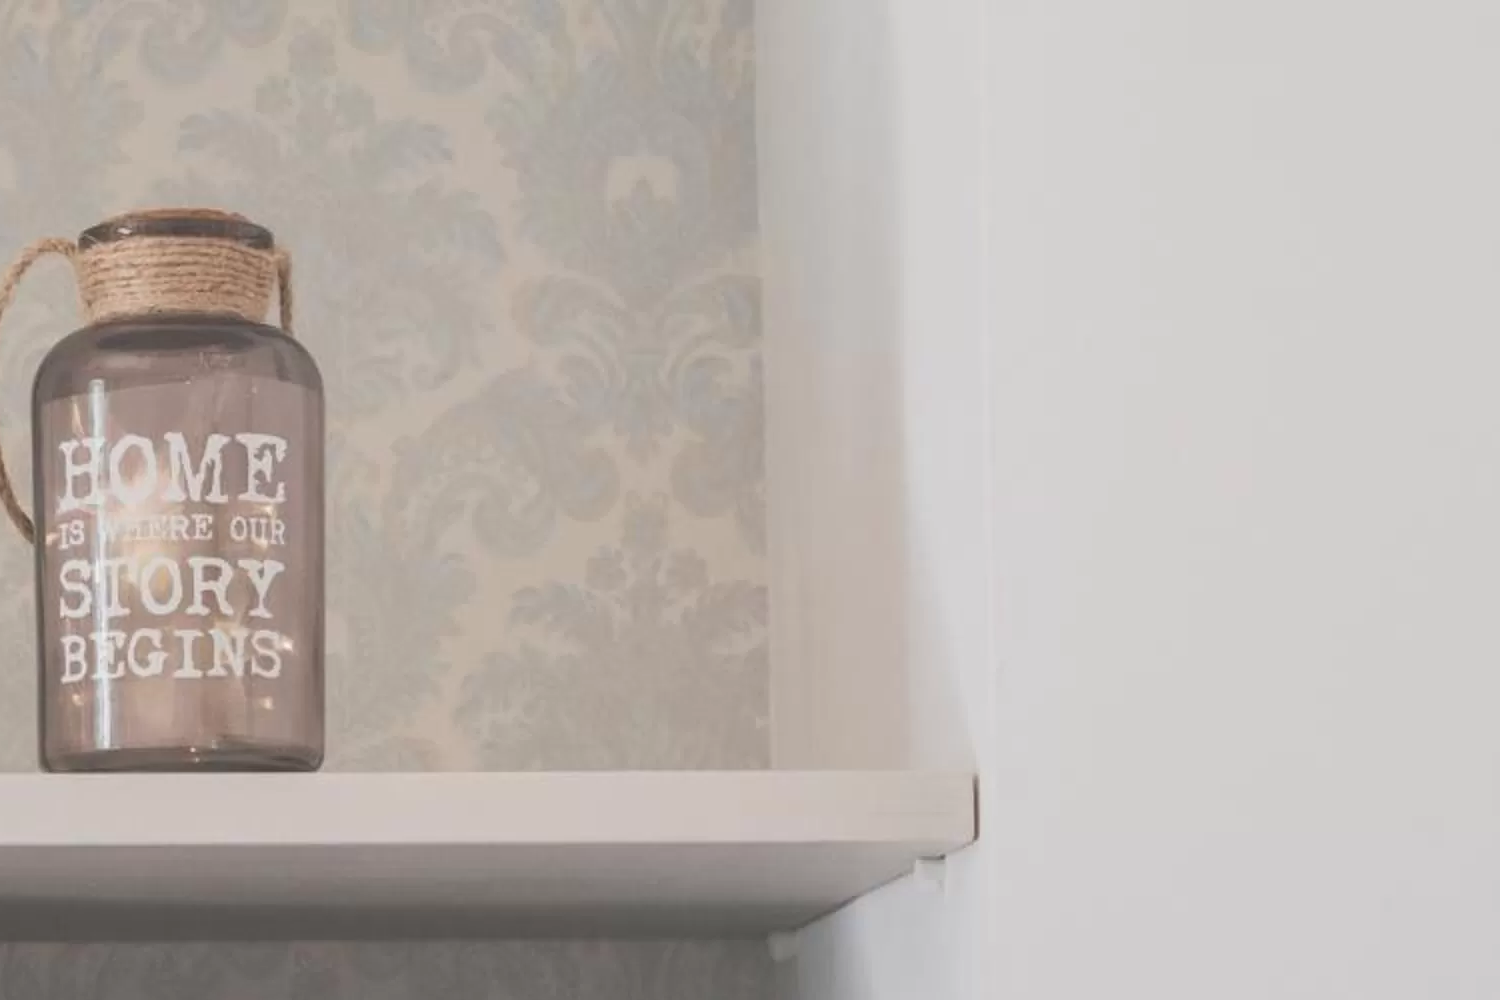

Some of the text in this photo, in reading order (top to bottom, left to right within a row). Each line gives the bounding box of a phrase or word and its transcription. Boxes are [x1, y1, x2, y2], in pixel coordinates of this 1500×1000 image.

[58, 432, 288, 513] HOME
[58, 513, 286, 549] IS WHERE OUR
[59, 556, 285, 619] STORY
[59, 628, 282, 684] BEGINS
